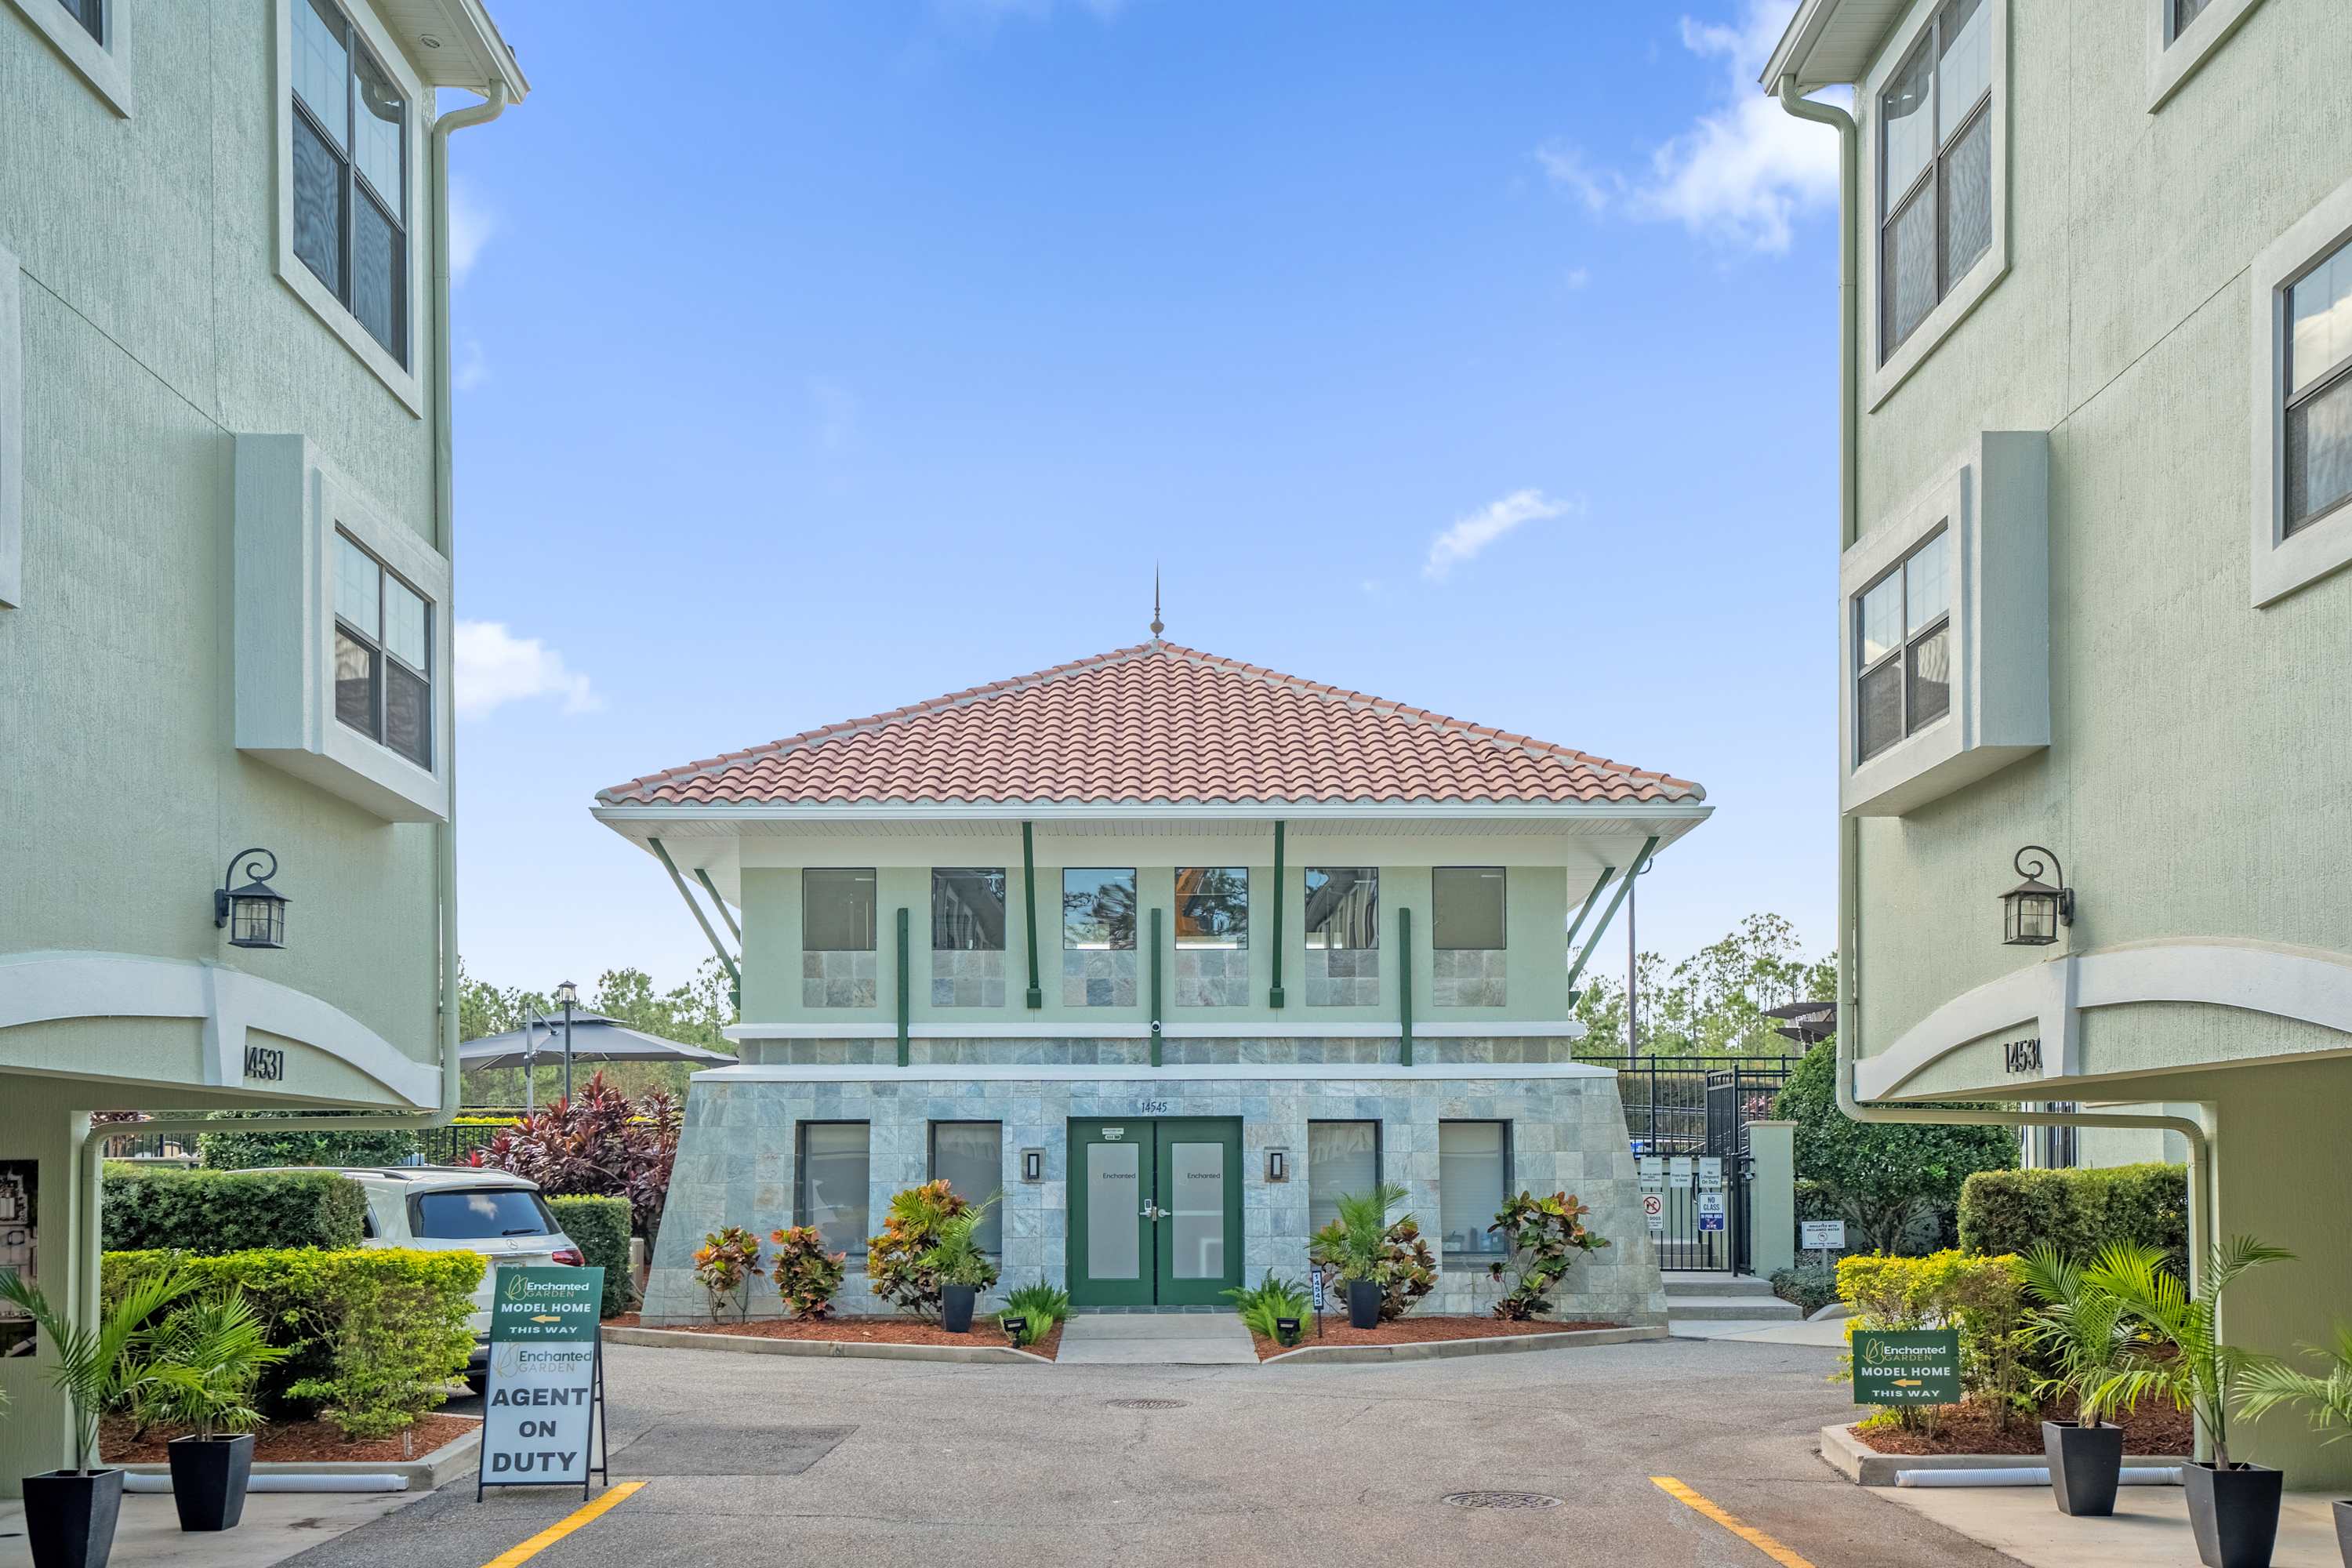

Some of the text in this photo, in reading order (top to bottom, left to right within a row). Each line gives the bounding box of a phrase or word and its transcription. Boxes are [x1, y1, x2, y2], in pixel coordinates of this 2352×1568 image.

[245, 1045, 284, 1080] 14531
[1142, 1102, 1167, 1112] 14545
[527, 1282, 590, 1291] Enchanted
[501, 1303, 591, 1313] MODEL HOME
[1884, 1345, 1946, 1355] Enchanted
[519, 1350, 592, 1362] Enchanted
[519, 1364, 575, 1373] GARDEN
[1861, 1367, 1951, 1376] MODEL HOME
[491, 1388, 588, 1406] AGENT
[518, 1421, 557, 1438] ON
[492, 1451, 577, 1472] DUTY
